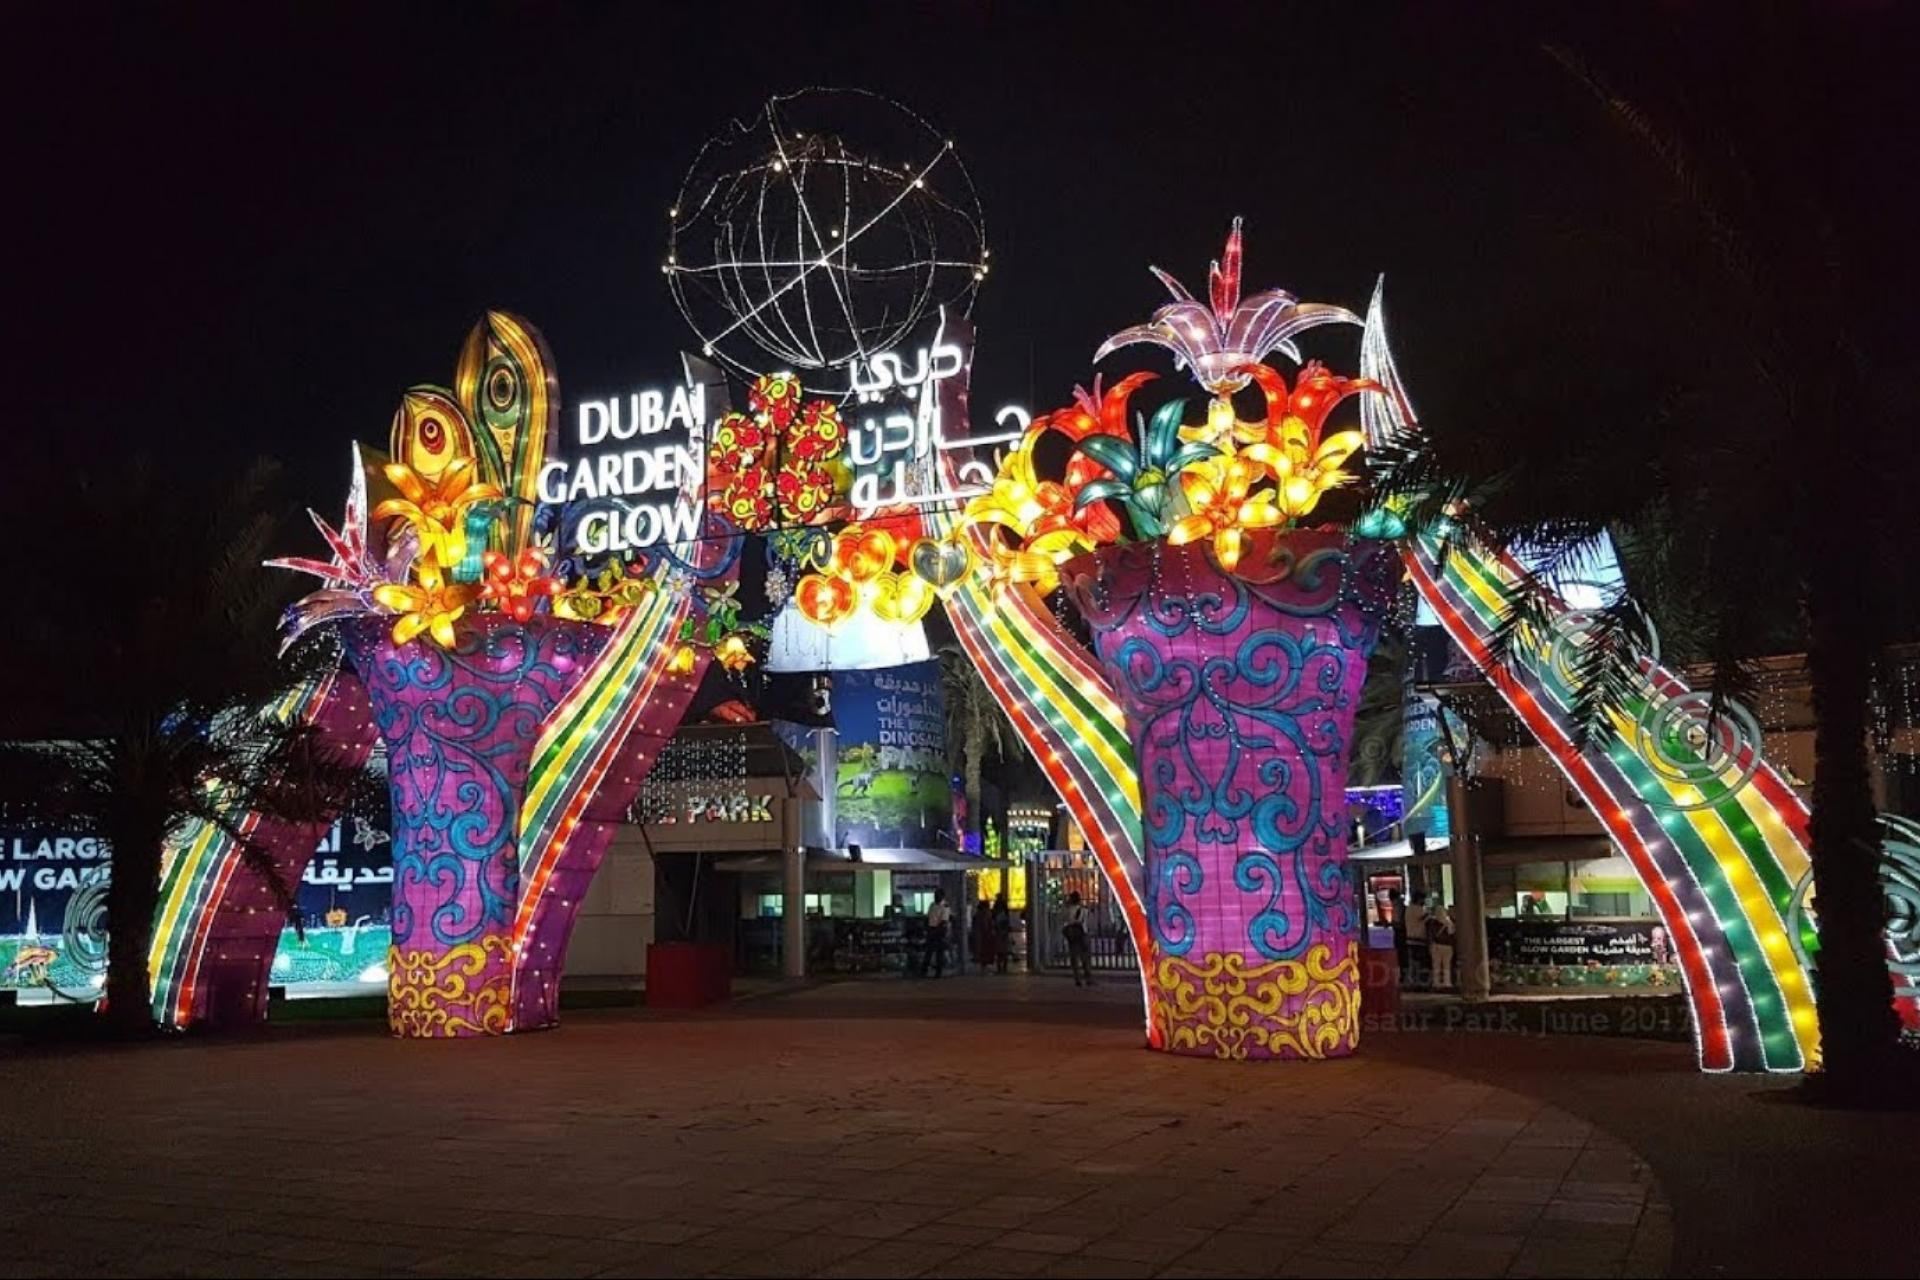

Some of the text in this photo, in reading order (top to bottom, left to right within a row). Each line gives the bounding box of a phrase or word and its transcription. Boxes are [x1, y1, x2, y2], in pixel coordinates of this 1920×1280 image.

[850, 345, 962, 403] دبي
[579, 383, 705, 445] DUBAI
[537, 444, 704, 504] GARDEN
[577, 499, 704, 553] GLOW
[877, 717, 905, 729] THE
[687, 795, 773, 824] PARK
